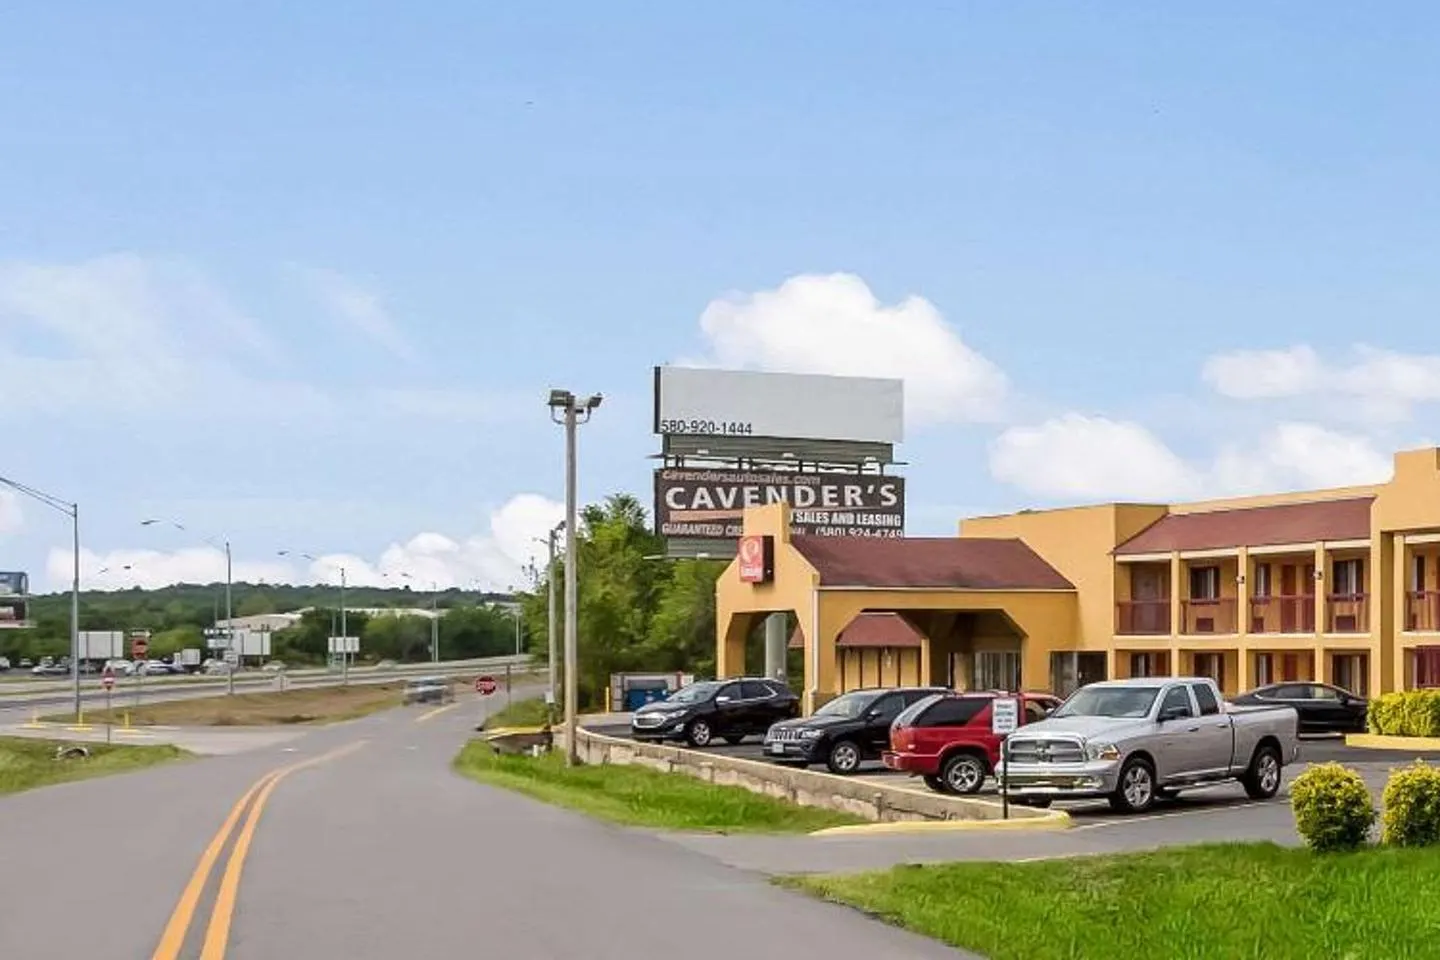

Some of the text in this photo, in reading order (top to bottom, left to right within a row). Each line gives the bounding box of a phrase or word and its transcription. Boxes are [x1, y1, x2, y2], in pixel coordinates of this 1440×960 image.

[661, 419, 753, 434] 580-920-1444
[665, 484, 898, 509] CAVENDER'S
[796, 512, 829, 524] SALES
[831, 513, 855, 525] AND
[857, 514, 901, 526] LEASING
[662, 523, 724, 536] GUARANTEED
